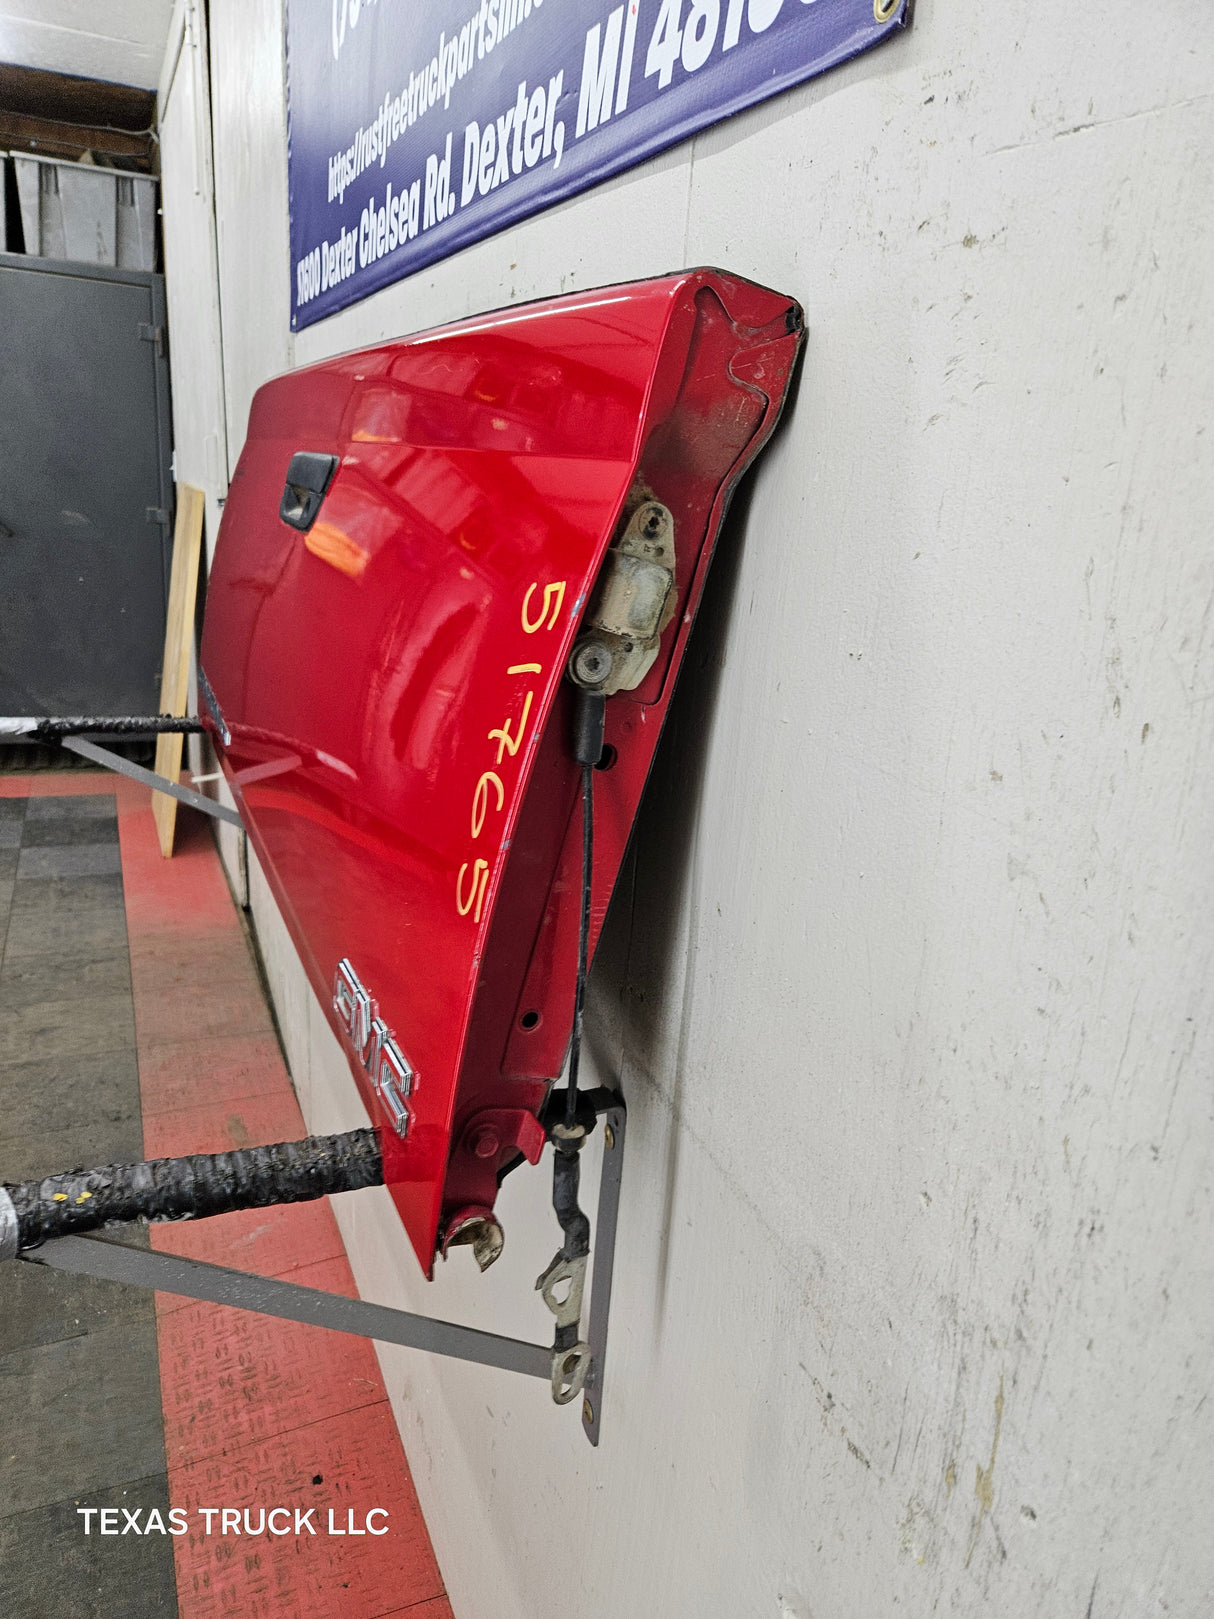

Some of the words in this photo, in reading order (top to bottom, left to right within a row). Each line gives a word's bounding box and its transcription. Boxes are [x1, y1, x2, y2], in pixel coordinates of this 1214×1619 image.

[322, 226, 358, 292] Dexter
[359, 179, 421, 269] Chelsea
[423, 132, 456, 230] Rd.
[461, 69, 565, 208] Dexter,
[575, 0, 640, 139] MI
[334, 957, 414, 1139] GMC
